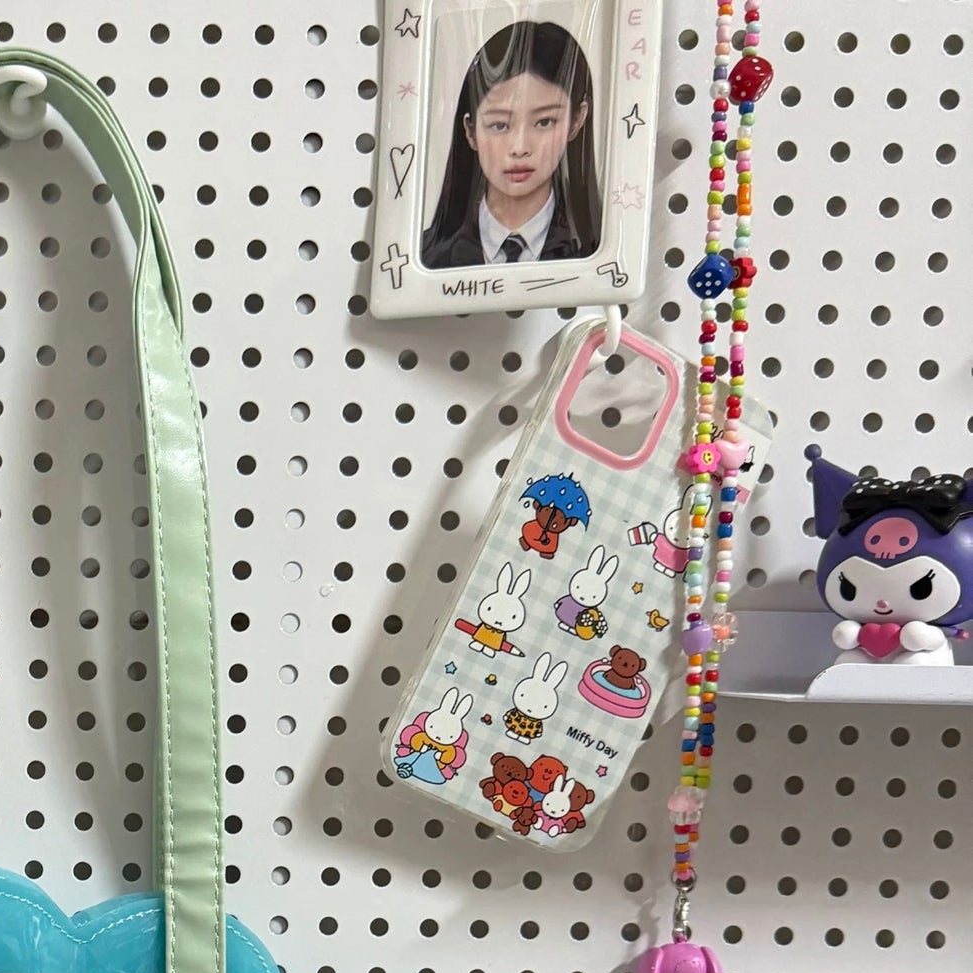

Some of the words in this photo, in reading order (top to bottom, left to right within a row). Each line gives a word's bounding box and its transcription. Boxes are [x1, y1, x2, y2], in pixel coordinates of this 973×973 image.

[441, 278, 505, 297] WHITE
[566, 726, 595, 748] Miffy
[595, 740, 619, 759] Day
